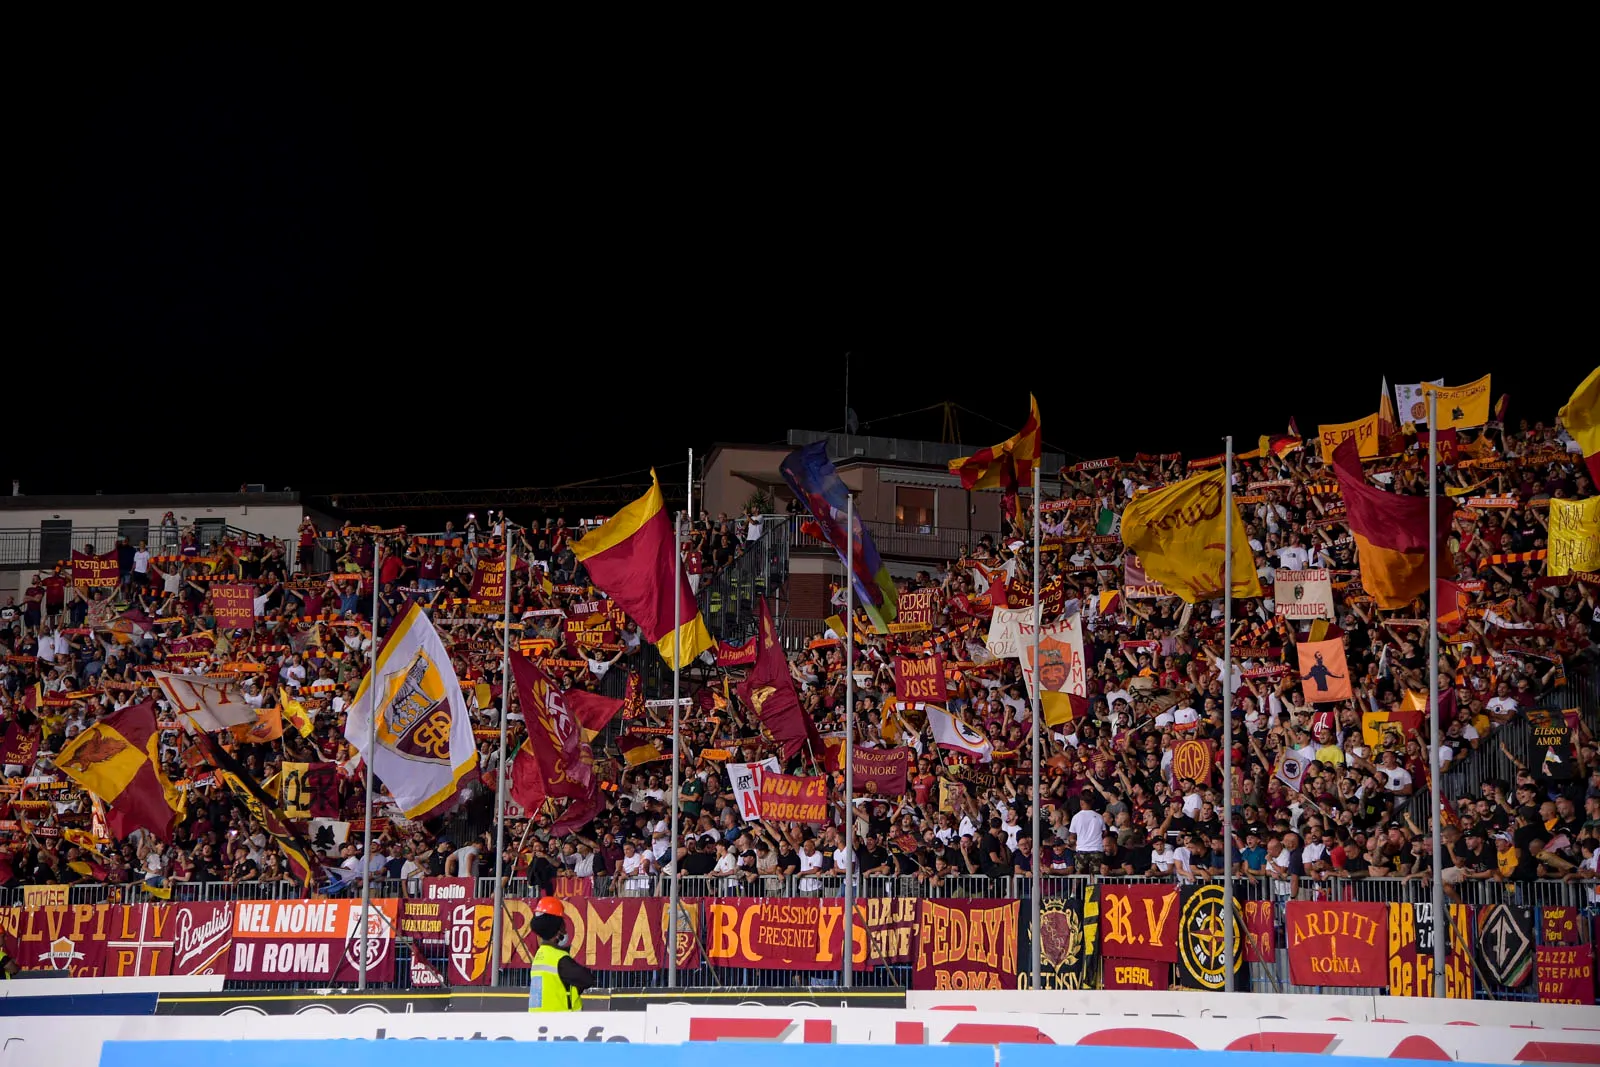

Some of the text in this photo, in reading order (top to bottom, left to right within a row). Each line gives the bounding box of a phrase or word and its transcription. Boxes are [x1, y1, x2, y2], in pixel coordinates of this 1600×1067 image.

[1082, 460, 1109, 471] ROMA
[1534, 726, 1568, 736] ETERNO
[1536, 736, 1562, 746] AMOR
[869, 765, 897, 776] MORE
[60, 793, 81, 801] ROMA
[762, 776, 800, 797] NUN
[762, 802, 827, 822] PROBLEMA
[436, 883, 466, 899] solito
[238, 903, 339, 933] NEL NOME
[760, 903, 818, 925] MASSIMO
[867, 897, 917, 927] DAJE
[21, 904, 110, 942] LVPI
[1293, 909, 1380, 947] ARDITI
[451, 904, 475, 982] ASR
[758, 926, 815, 948] PRESENTE
[917, 899, 1021, 975] FEDAYN
[233, 942, 330, 974] DI ROMA
[1310, 956, 1361, 974] ROMA
[934, 969, 1002, 990] ROMA
[1389, 955, 1413, 997] De
[1537, 965, 1591, 980] STEFANO
